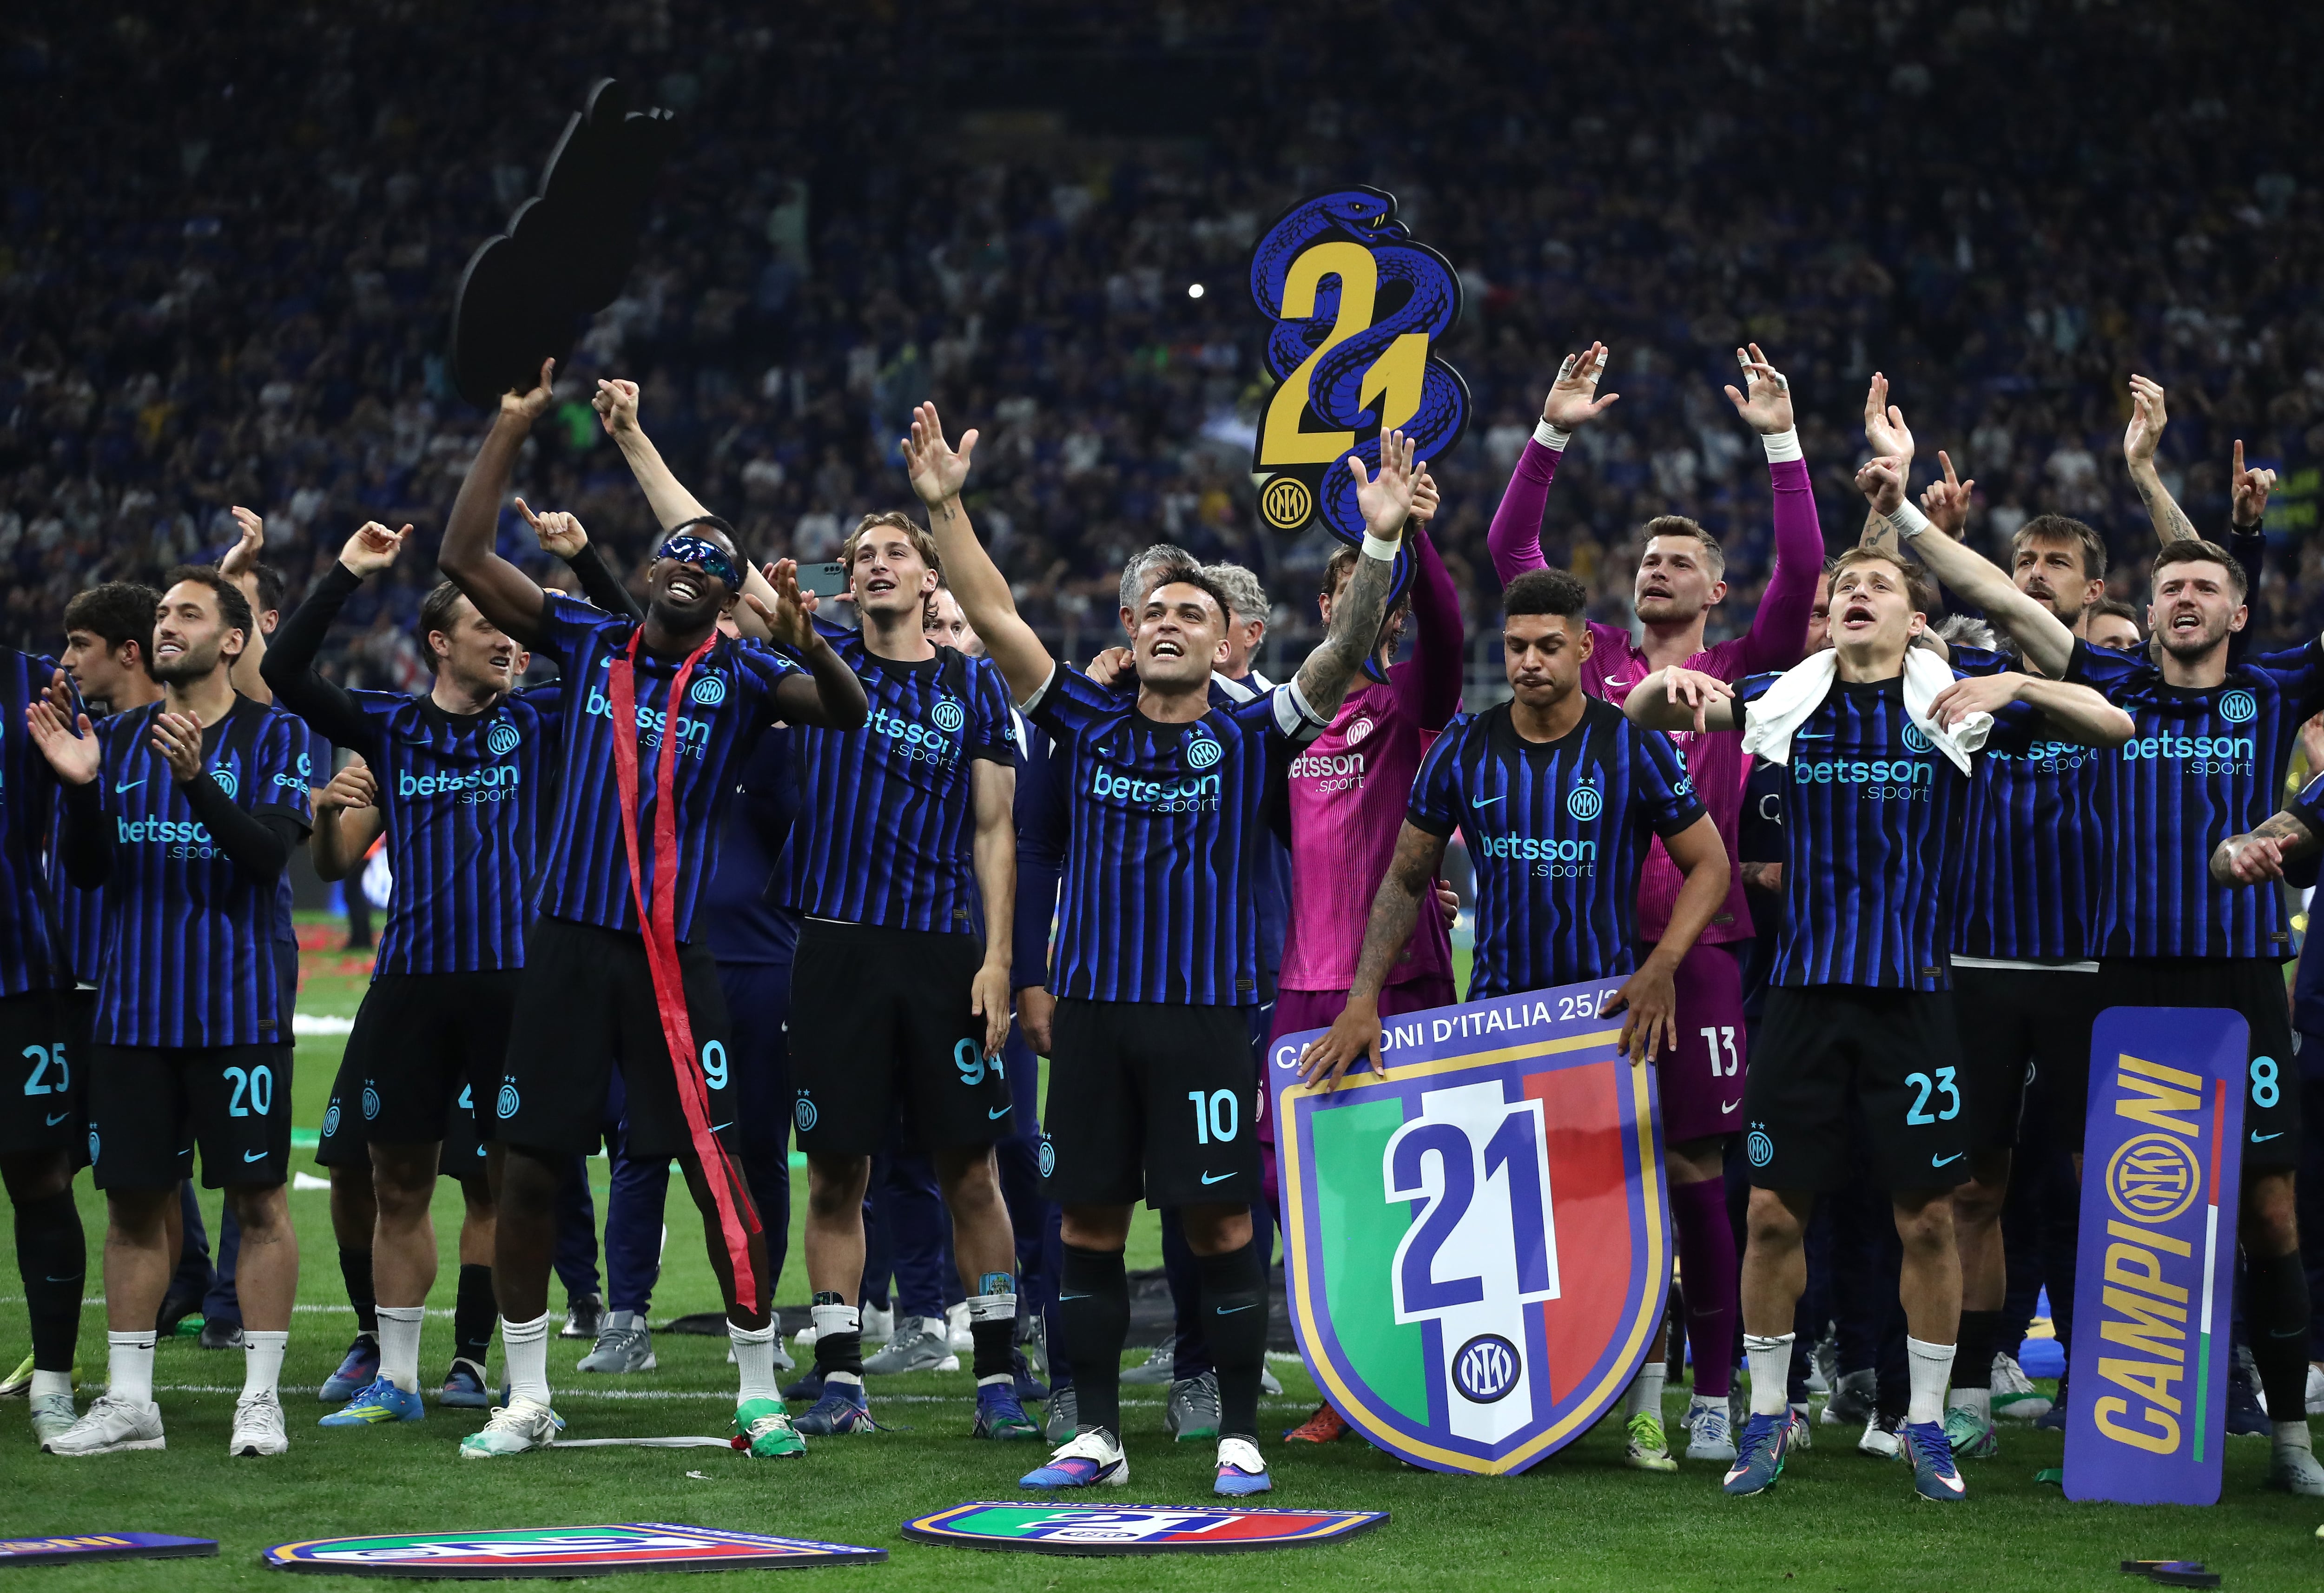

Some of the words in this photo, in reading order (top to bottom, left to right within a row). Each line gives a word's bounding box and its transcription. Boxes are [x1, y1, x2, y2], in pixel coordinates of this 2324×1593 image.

[1260, 241, 1429, 465] 21
[892, 744, 956, 771] .sport
[1795, 756, 1932, 785] betsson
[2186, 760, 2253, 777] .sport
[399, 765, 519, 796] betsson
[457, 785, 517, 806] .sport
[1093, 765, 1220, 802] betsson
[1316, 773, 1365, 794] .sport
[1862, 784, 1930, 802] .sport
[1152, 795, 1219, 813] .sport
[117, 814, 212, 844] betsso
[1478, 831, 1596, 861] betsson
[1532, 862, 1594, 880] .sport
[1433, 1002, 1552, 1043] D'ITALIA
[702, 1040, 727, 1090] 9
[1700, 1026, 1738, 1077] 13
[22, 1043, 69, 1096] 25
[2250, 1056, 2280, 1108] 8
[223, 1065, 272, 1117] 20
[1905, 1066, 1961, 1126] 23
[1188, 1089, 1238, 1144] 10
[1393, 1110, 1550, 1313] 21
